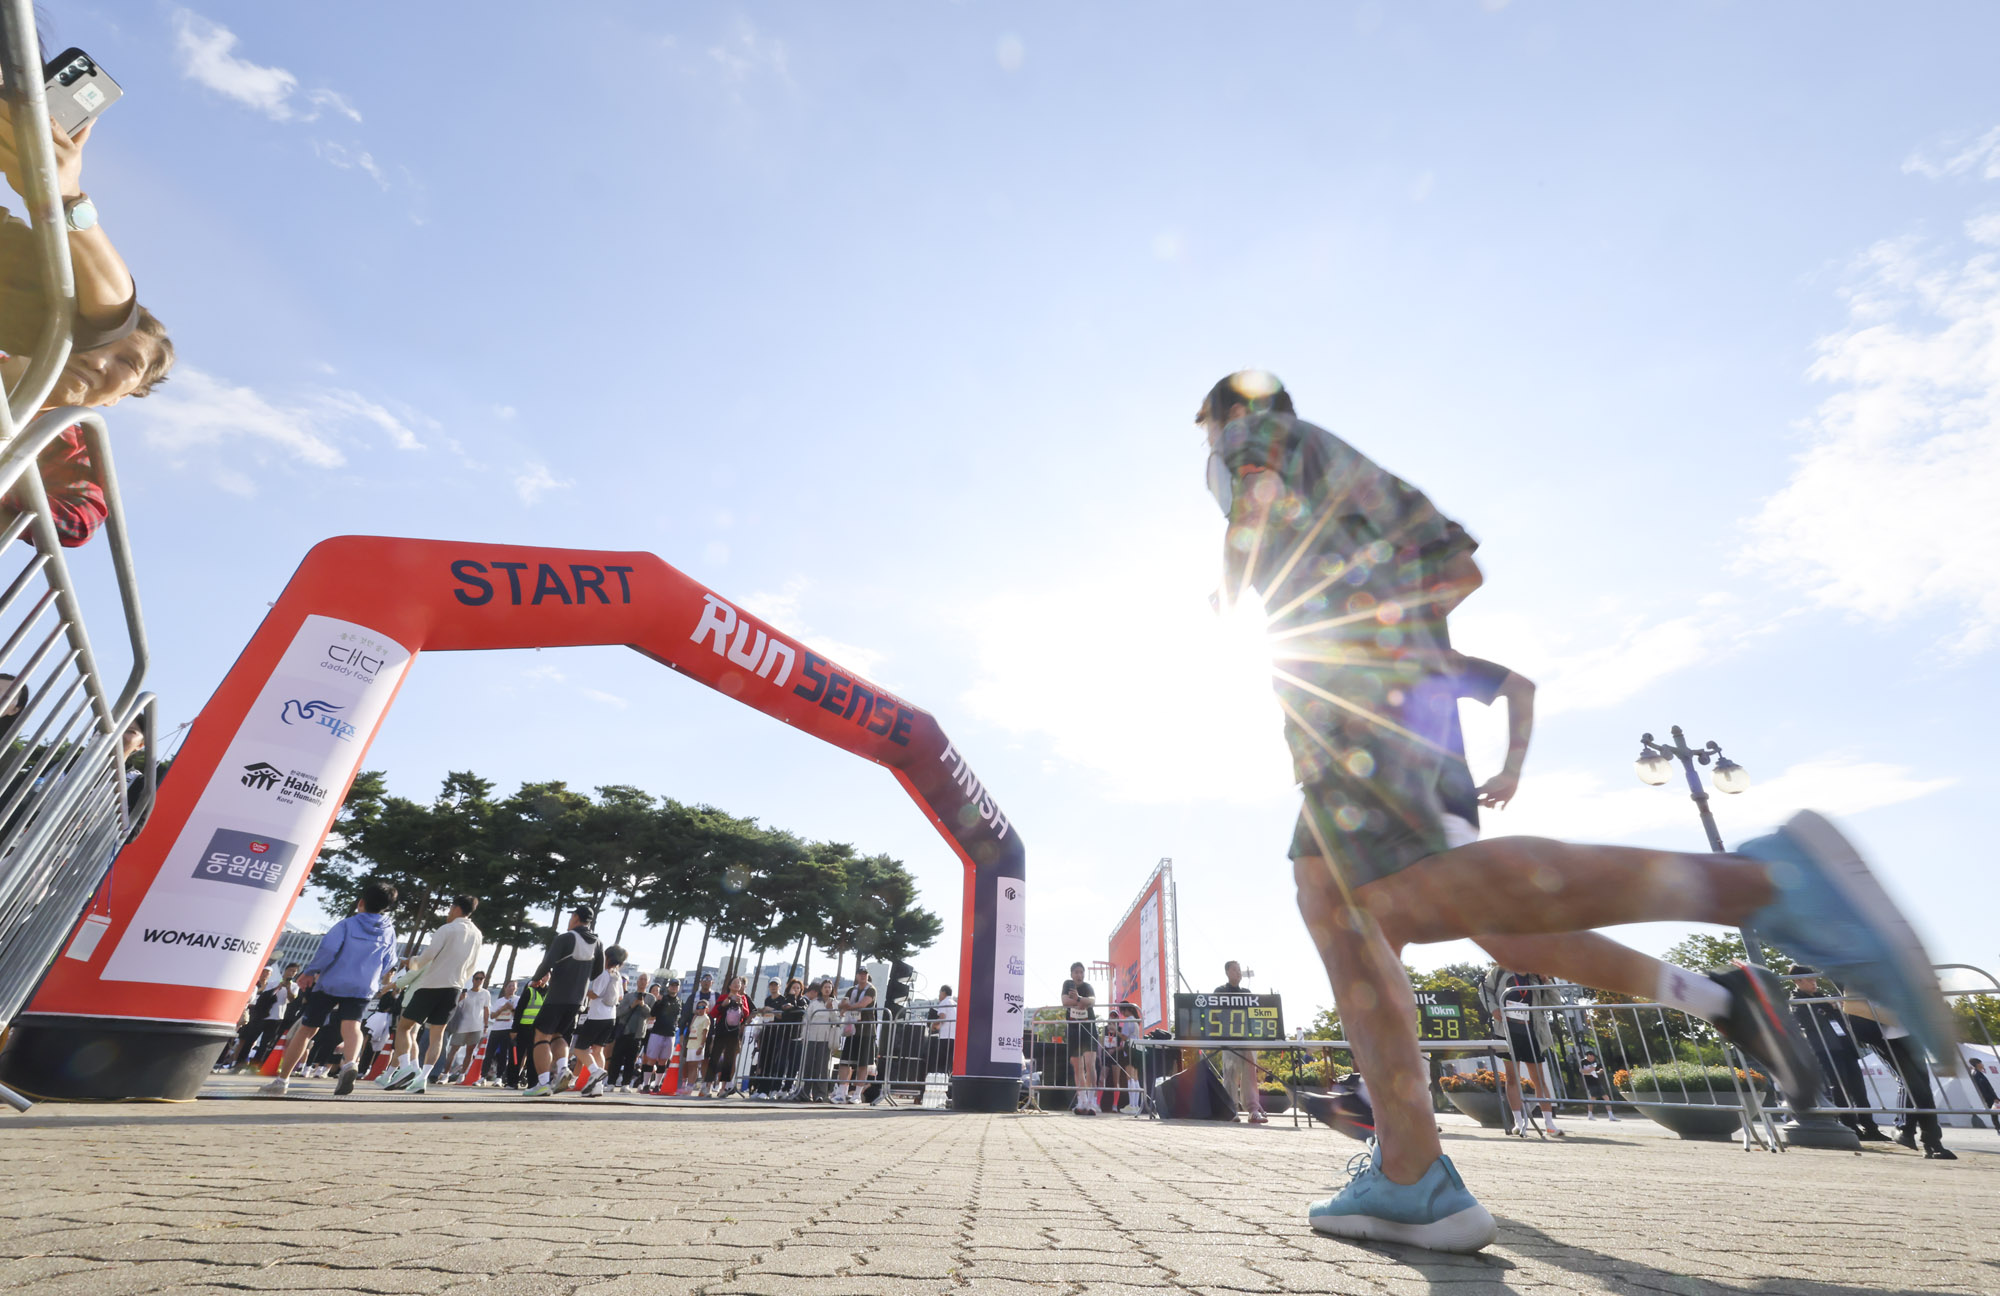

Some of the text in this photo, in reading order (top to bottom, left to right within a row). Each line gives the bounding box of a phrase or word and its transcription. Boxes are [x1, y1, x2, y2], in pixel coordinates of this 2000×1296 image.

[451, 560, 634, 606] START
[320, 661, 374, 684] daddy food
[280, 788, 322, 807] for Humanity
[284, 776, 327, 799] Habitat
[940, 741, 1009, 840] FINISH
[276, 796, 294, 804] Korea
[206, 852, 283, 884] 동원샘물
[144, 928, 261, 955] WOMAN SENSE
[1208, 996, 1260, 1006] SAMIK
[1430, 1006, 1455, 1015] 10km
